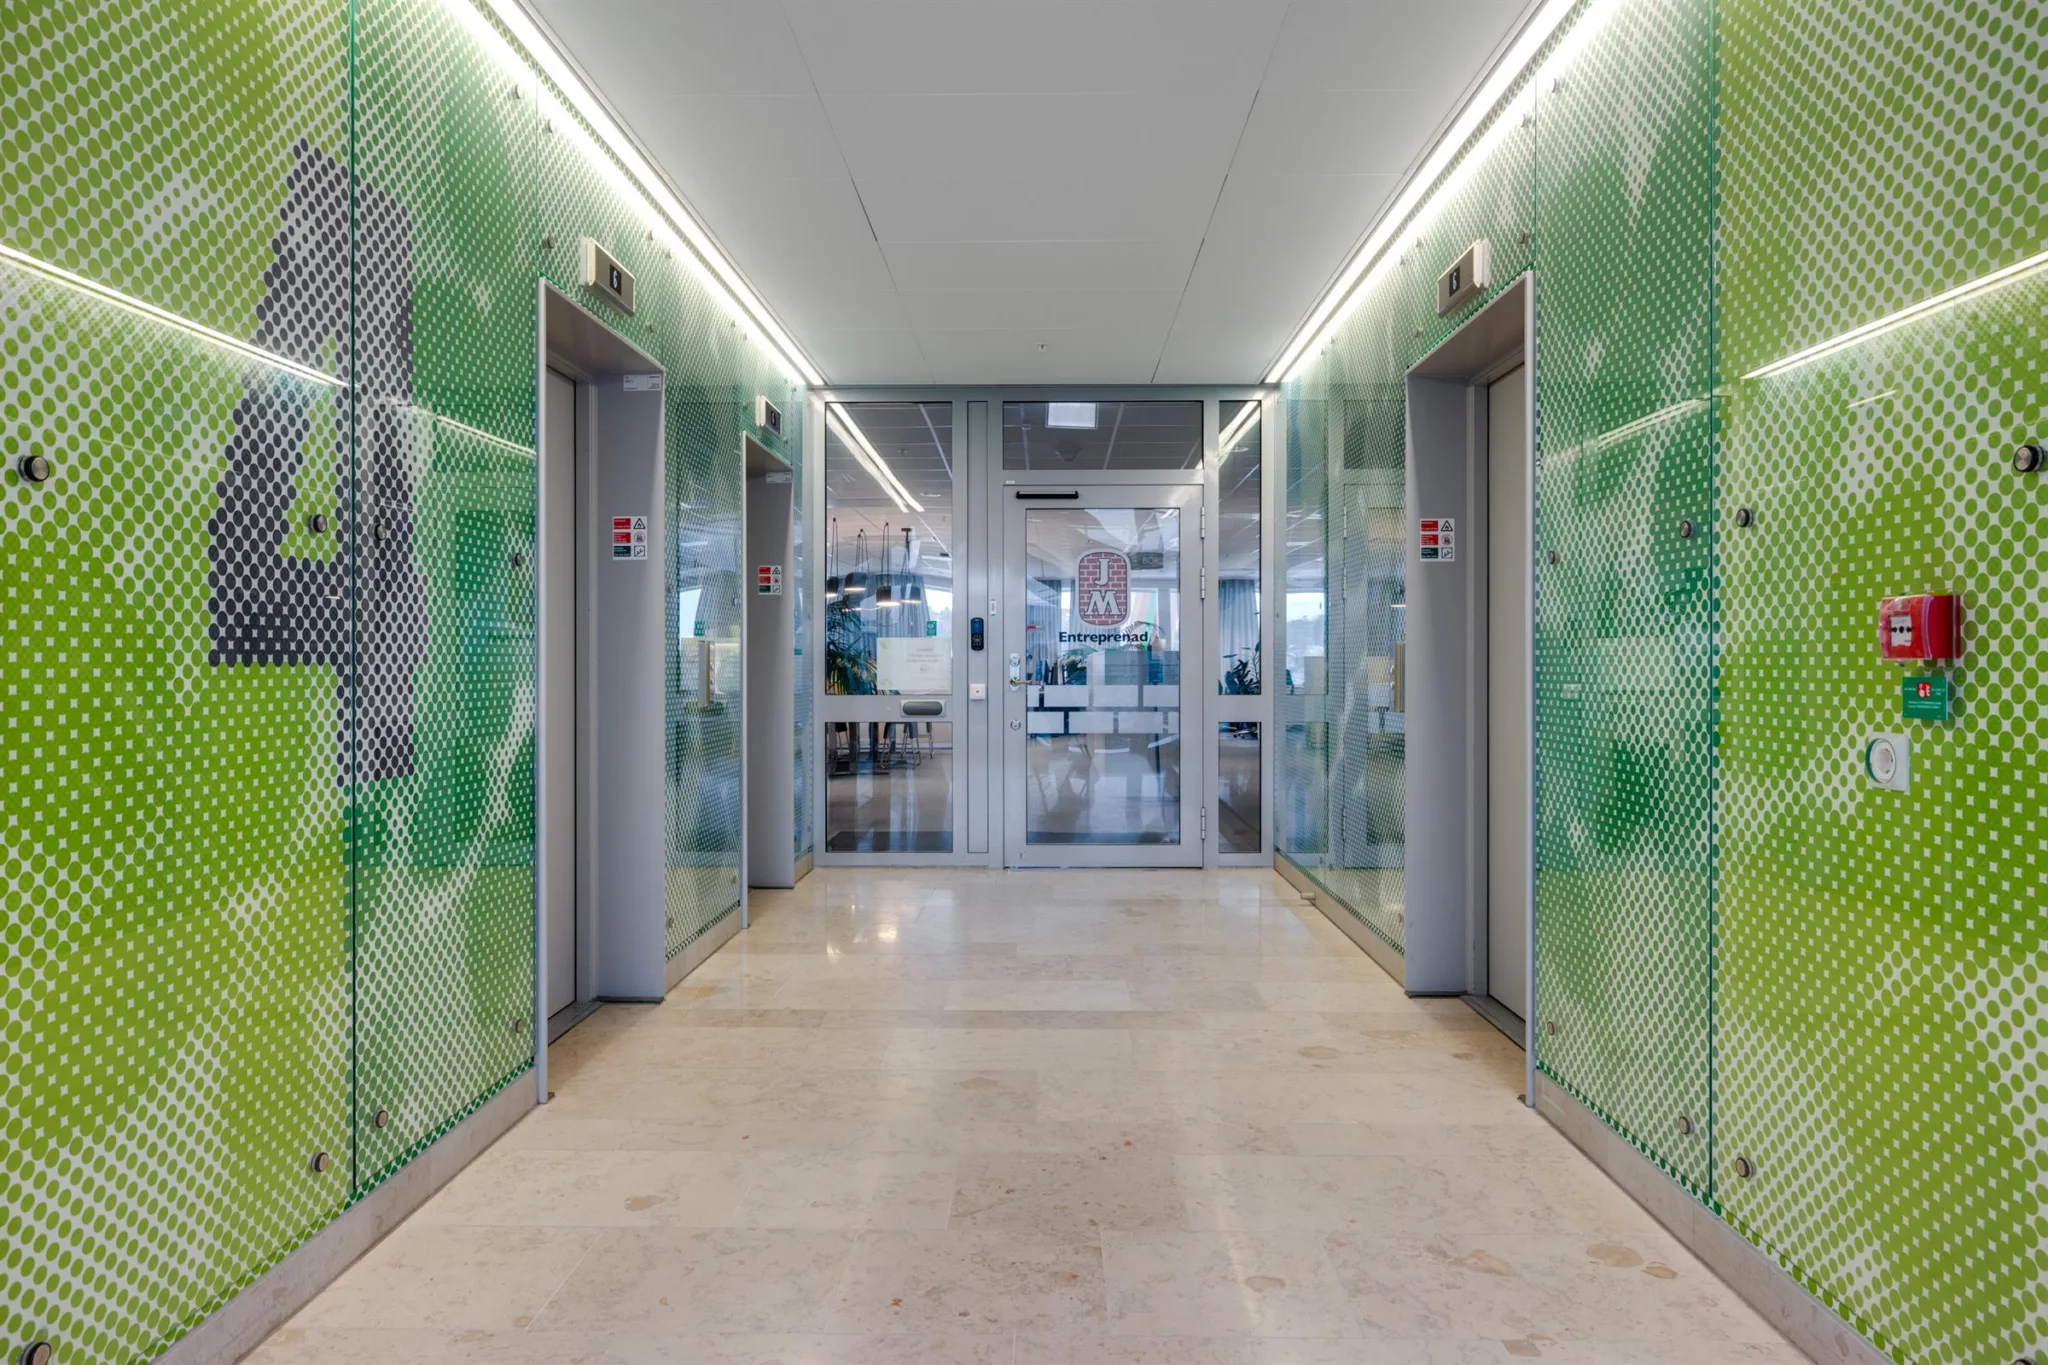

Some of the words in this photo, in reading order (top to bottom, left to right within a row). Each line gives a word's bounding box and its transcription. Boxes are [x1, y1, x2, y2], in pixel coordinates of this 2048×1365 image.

[612, 270, 618, 289] 6
[208, 138, 429, 784] 4
[1058, 631, 1149, 646] Entreprenad
